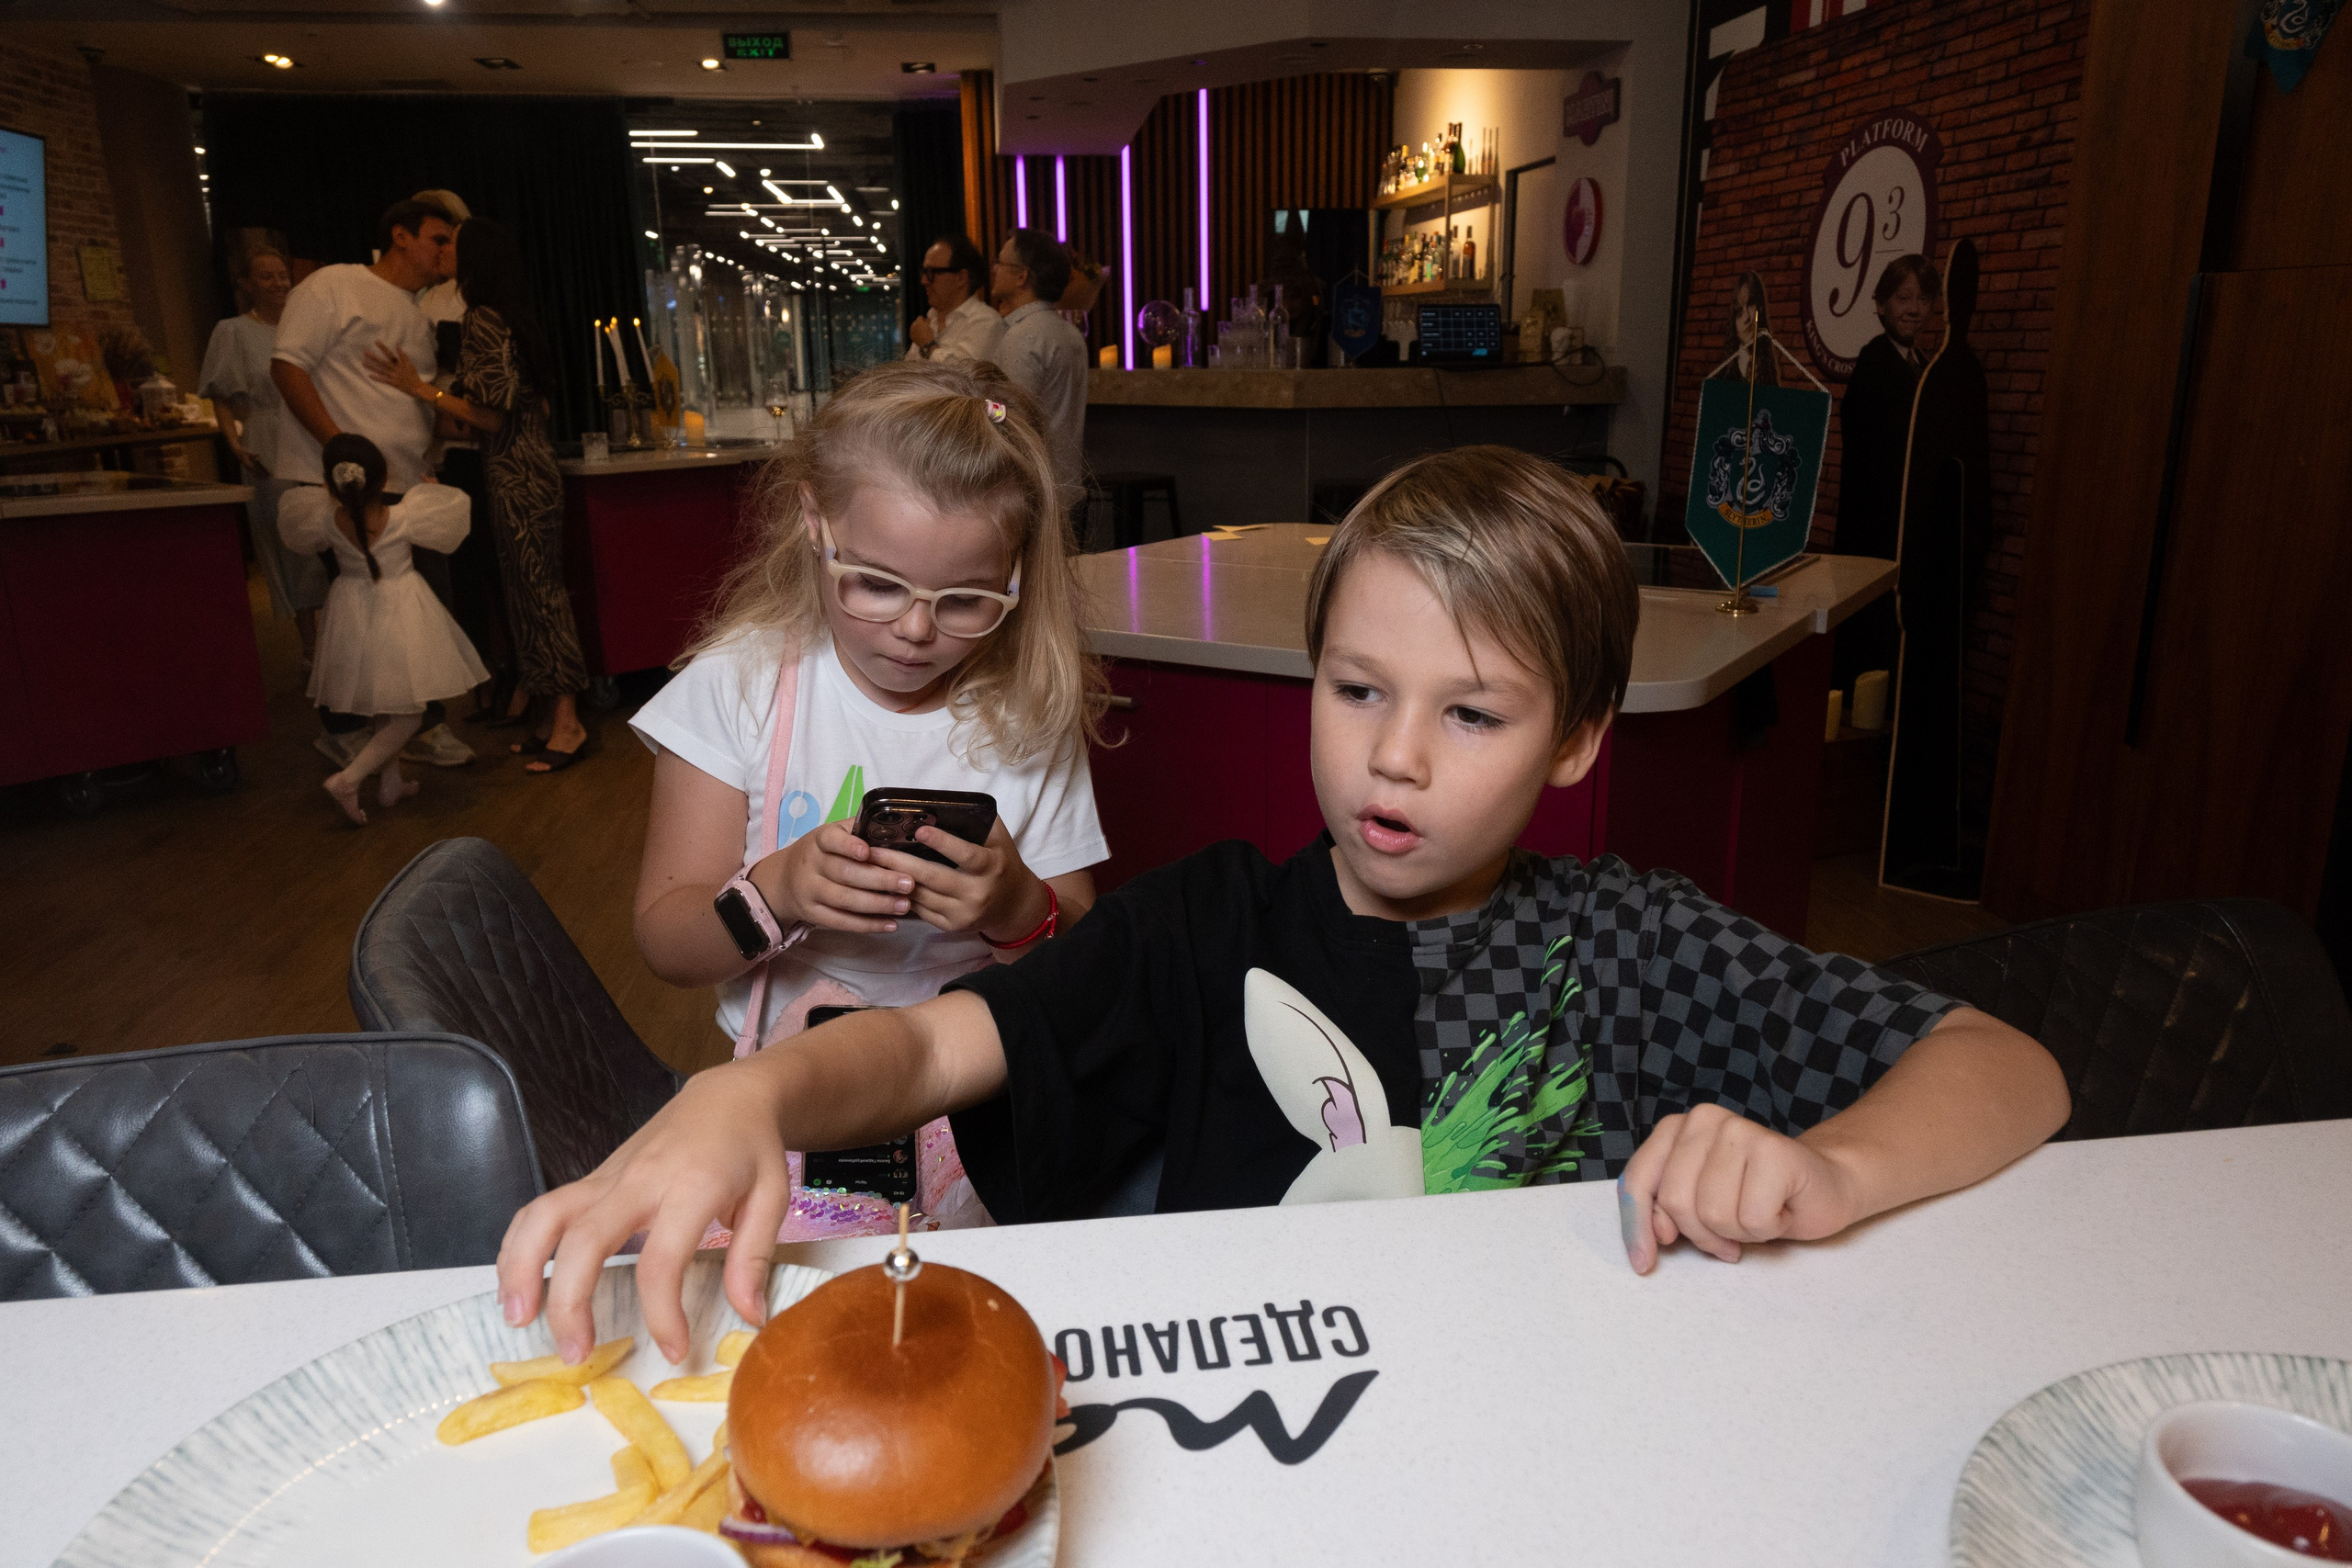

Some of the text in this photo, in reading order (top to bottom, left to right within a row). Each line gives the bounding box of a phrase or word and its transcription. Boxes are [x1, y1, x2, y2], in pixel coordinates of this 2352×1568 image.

[728, 37, 784, 49] ВЫХОД
[737, 49, 775, 57] EXIT
[1838, 117, 1930, 168] PLATFORM
[1054, 1298, 1371, 1382] СДЕЛАНО
